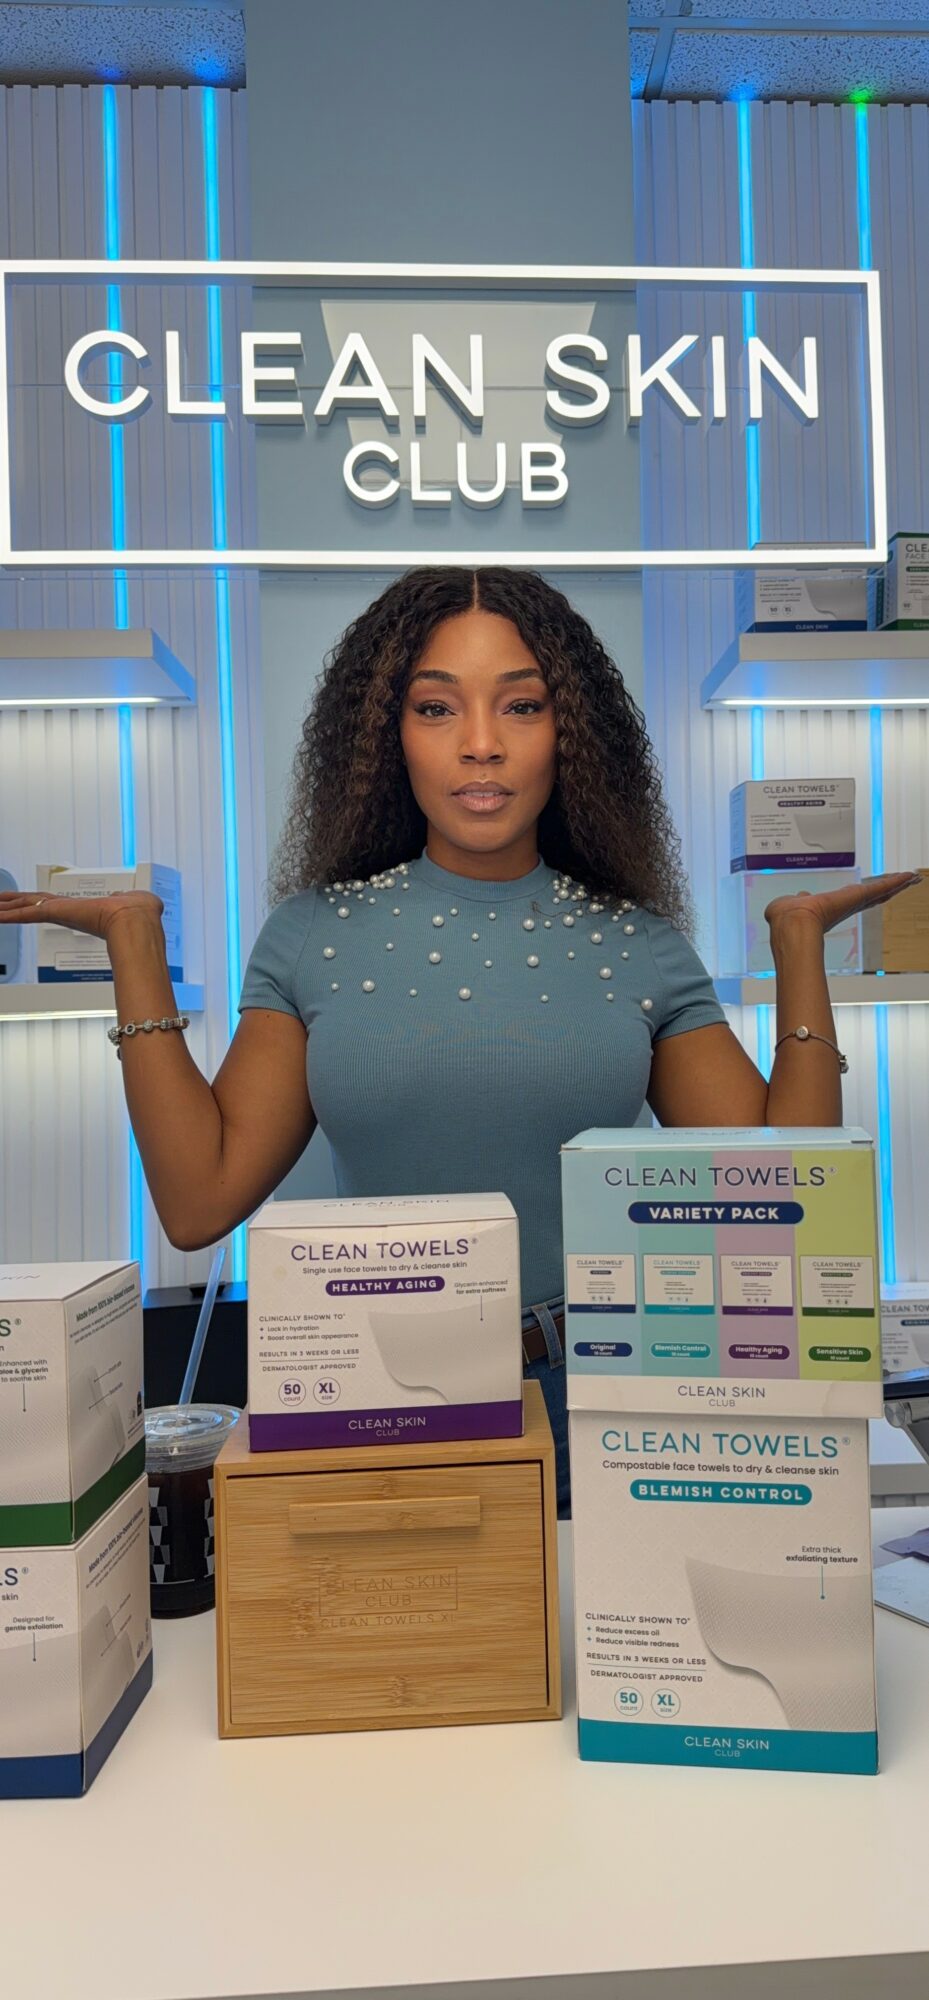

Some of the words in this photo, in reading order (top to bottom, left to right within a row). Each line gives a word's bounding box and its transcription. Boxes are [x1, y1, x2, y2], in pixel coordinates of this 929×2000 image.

[64, 330, 484, 424] CLEAN
[544, 333, 820, 428] SKIN
[343, 441, 569, 508] CLUB
[763, 786, 794, 794] CLEAN
[604, 1167, 697, 1187] CLEAN
[649, 1207, 725, 1220] VARIETY
[732, 1207, 780, 1220] PACK
[291, 1244, 367, 1261] CLEAN
[302, 1266, 326, 1275] Single
[343, 1265, 360, 1273] face
[362, 1264, 387, 1272] towels
[398, 1263, 412, 1272] dry
[420, 1262, 450, 1270] cleanse
[332, 1282, 391, 1293] HEALTHY
[396, 1279, 437, 1290] AGING
[880, 1305, 910, 1313] CLEAN
[590, 1344, 616, 1352] Original
[736, 1346, 761, 1354] Healthy
[763, 1347, 783, 1355] Aging
[21, 1367, 48, 1375] glycerin
[284, 1384, 301, 1395] 50
[319, 1382, 335, 1394] XL
[677, 1385, 726, 1397] CLEAN
[732, 1386, 766, 1398] SKIN
[708, 1399, 736, 1407] CLUB
[348, 1419, 392, 1430] CLEAN
[396, 1416, 426, 1427] SKIN
[376, 1429, 400, 1437] CLUB
[602, 1430, 700, 1453] CLEAN
[602, 1460, 670, 1472] Compostable
[672, 1462, 695, 1472] face
[698, 1463, 730, 1472] towels
[732, 1465, 743, 1473] to
[745, 1464, 762, 1475] dry
[765, 1465, 773, 1474] &
[775, 1465, 815, 1475] cleanse
[818, 1466, 839, 1476] skin
[639, 1484, 712, 1498] BLEMISH
[720, 1487, 803, 1500] CONTROL
[802, 1546, 820, 1554] Extra
[822, 1546, 842, 1554] thick
[785, 1554, 828, 1565] exfoliating
[829, 1556, 858, 1564] texture
[326, 1577, 393, 1593] LEAN
[404, 1574, 451, 1589] SKIN
[2, 1592, 19, 1600] skin
[365, 1594, 413, 1607] CLUB
[12, 1616, 44, 1624] Designed
[321, 1618, 368, 1629] CLEAN
[376, 1614, 434, 1625] TOWELS
[585, 1612, 636, 1623] CLINICALLY
[639, 1616, 673, 1625] SHOWN
[5, 1625, 26, 1633] gentle
[595, 1626, 623, 1635] Reduce
[651, 1629, 660, 1637] oil
[595, 1637, 623, 1646] Reduce
[624, 1638, 648, 1646] visible
[650, 1639, 680, 1648] redness
[586, 1652, 620, 1662] RESULTS
[622, 1654, 631, 1662] IN
[641, 1656, 669, 1664] WEEKS
[672, 1657, 684, 1665] OR
[687, 1658, 706, 1666] LESS
[590, 1669, 656, 1680] DERMATOLOGIST
[659, 1673, 703, 1683] APPROVED
[620, 1692, 638, 1704] 50
[656, 1694, 675, 1706] XL
[620, 1704, 638, 1712] count
[684, 1736, 731, 1748] CLEAN
[737, 1738, 770, 1750] SKIN
[714, 1749, 741, 1758] CLUB
